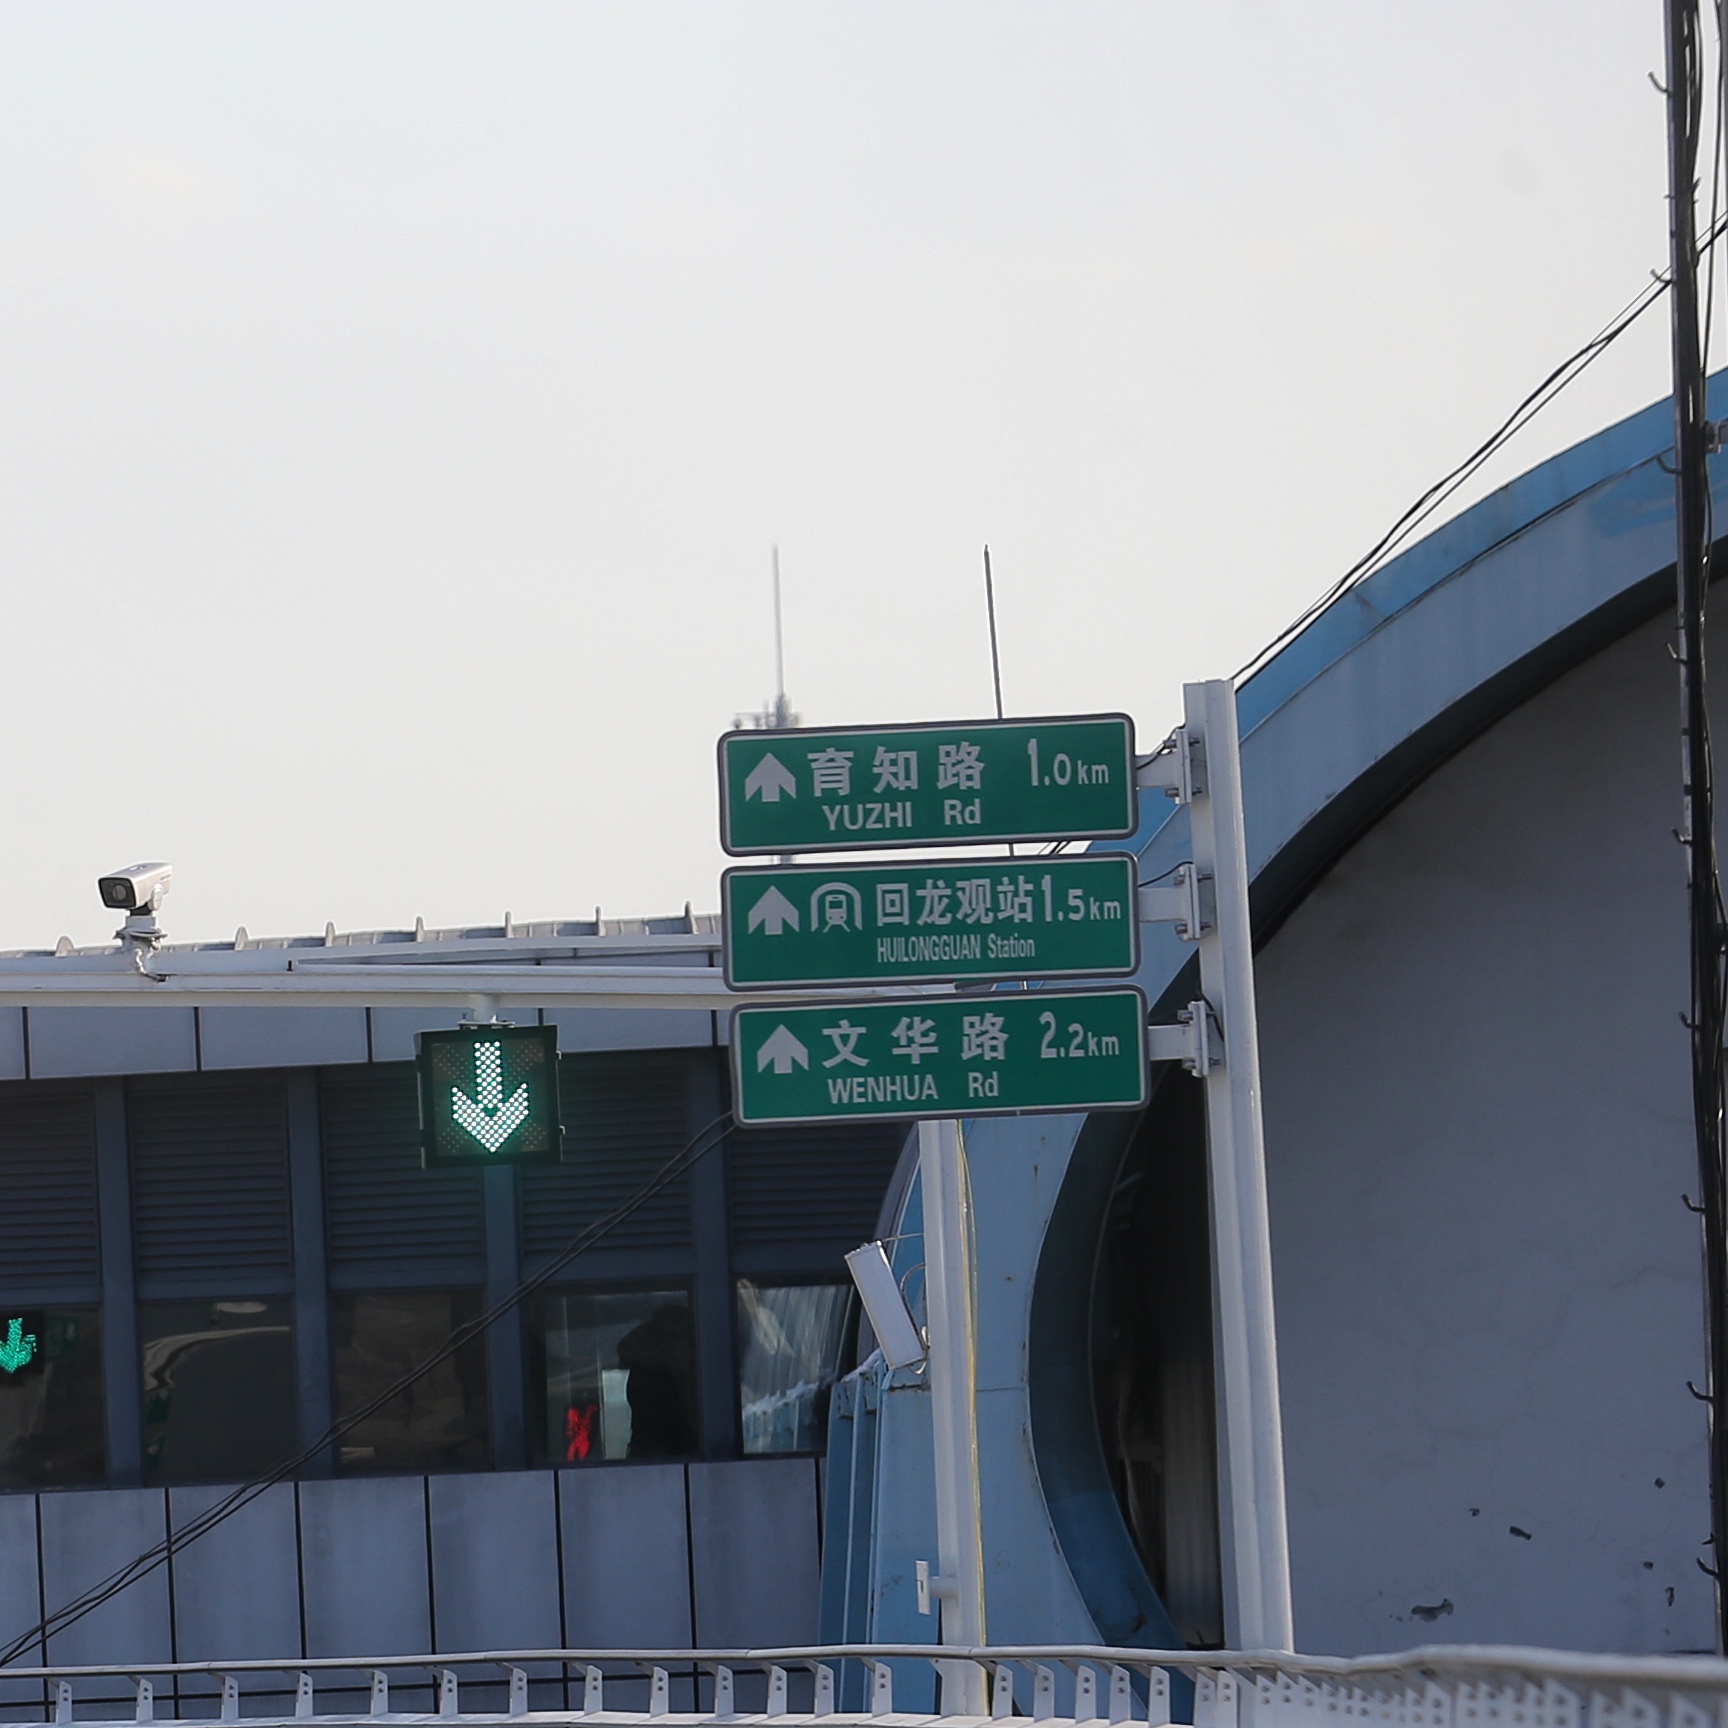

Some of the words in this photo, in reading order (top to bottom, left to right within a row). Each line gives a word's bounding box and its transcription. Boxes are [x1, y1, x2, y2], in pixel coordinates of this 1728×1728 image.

[807, 741, 985, 797] 育知路
[822, 801, 912, 831] YUZHI
[943, 798, 982, 826] Rd
[876, 875, 1035, 927] 回龙观站
[877, 934, 981, 963] HUILONGGUAN
[987, 933, 1036, 959] Station
[822, 1012, 1009, 1069] 文华路
[827, 1073, 939, 1105] WENHUA
[968, 1071, 999, 1098] Rd
